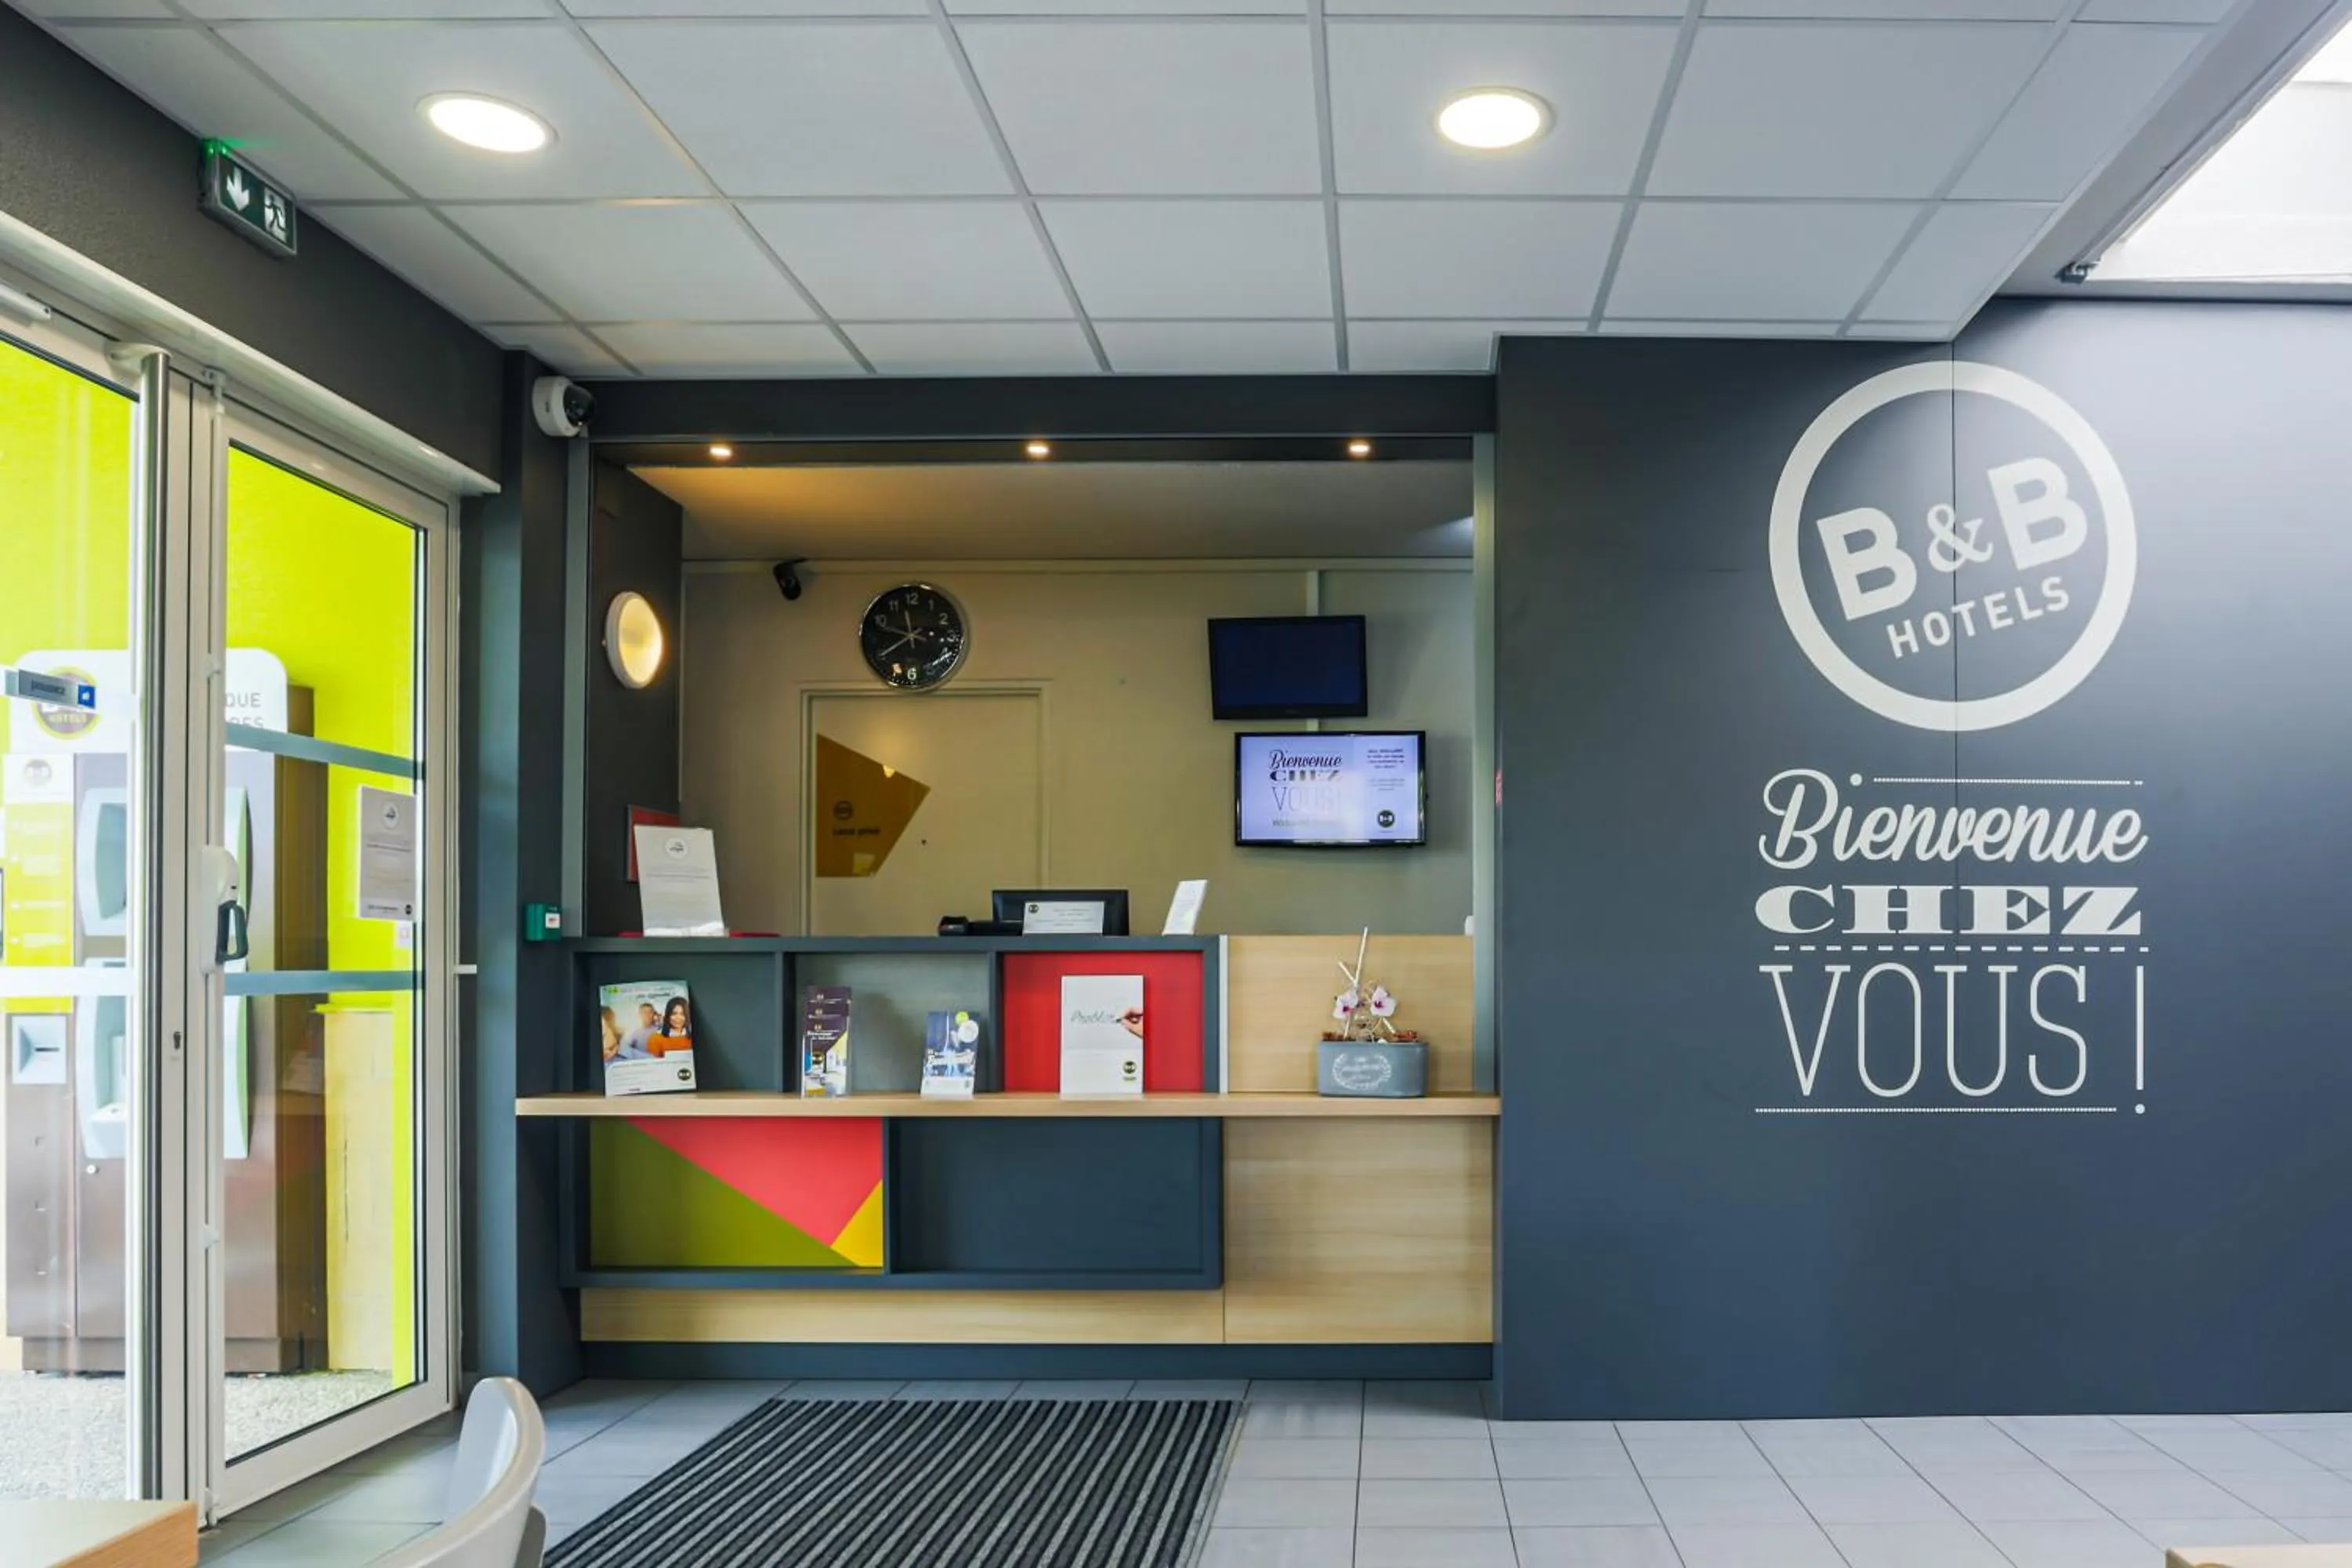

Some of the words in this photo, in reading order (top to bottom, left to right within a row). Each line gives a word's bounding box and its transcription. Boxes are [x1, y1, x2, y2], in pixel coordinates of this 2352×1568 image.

[888, 600, 899, 612] 11
[905, 593, 919, 605] 12
[928, 599, 935, 611] 1
[875, 614, 887, 628] 10
[939, 612, 949, 625] 2
[1886, 575, 2071, 659] HOTELS
[907, 668, 916, 681] 6
[1269, 749, 1342, 769] Bienvenue
[1758, 769, 2148, 869] Bienvenue
[1755, 884, 2141, 935] CHEZ
[1759, 963, 2088, 1098] VOUS
